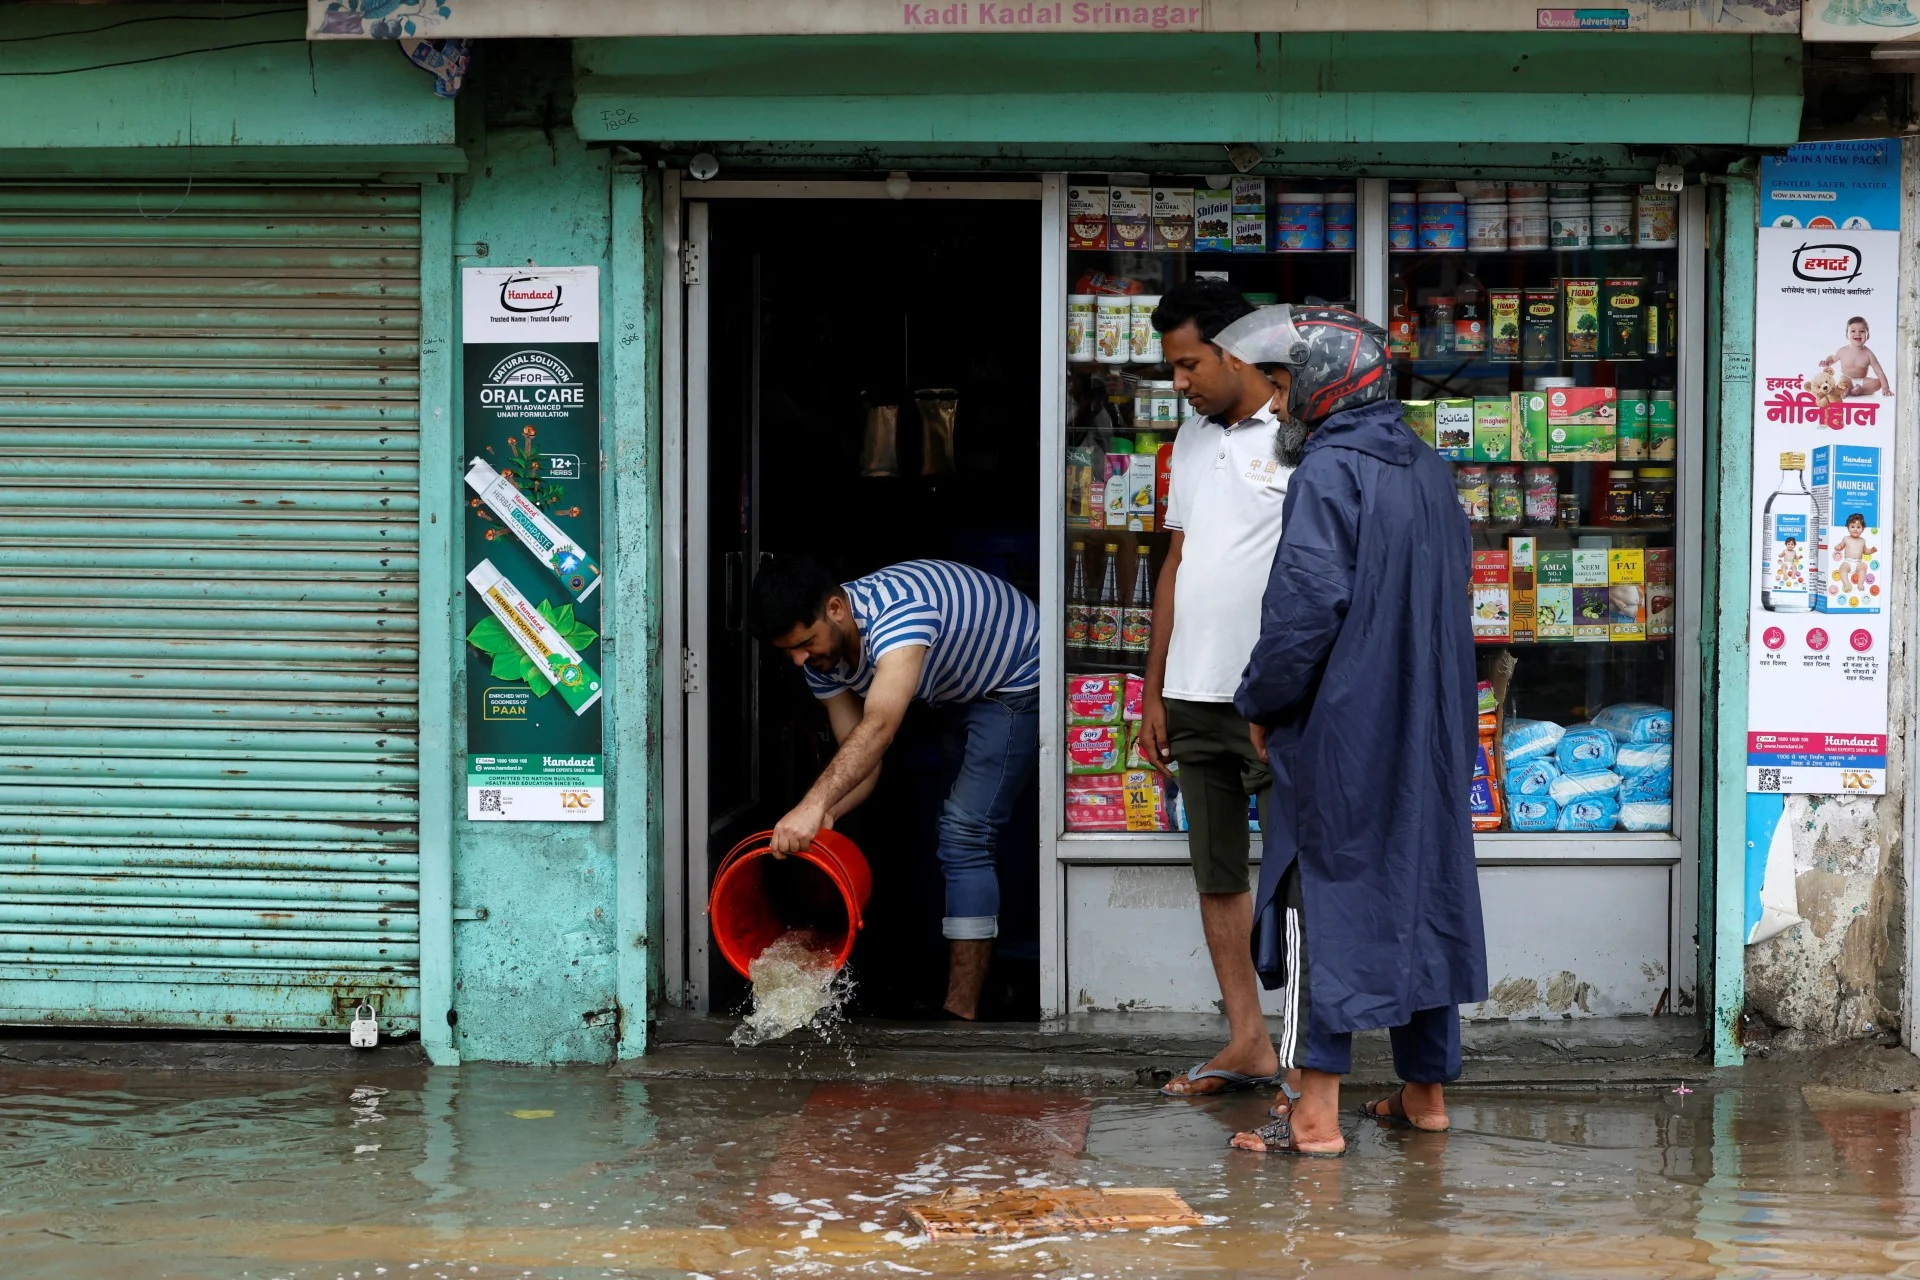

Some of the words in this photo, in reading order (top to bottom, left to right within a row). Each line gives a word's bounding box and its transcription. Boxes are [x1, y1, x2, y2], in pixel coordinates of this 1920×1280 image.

[904, 3, 968, 24] Kadi
[979, 2, 1062, 24] Kadal
[1072, 2, 1200, 28] Srinagar
[1581, 18, 1626, 26] Advertisers
[1820, 143, 1833, 151] BY
[1836, 142, 1884, 151] BILLIONS
[1773, 155, 1798, 164] NOW
[1802, 155, 1814, 164] IN
[1815, 156, 1824, 164] A
[1827, 155, 1848, 165] NEW
[1853, 155, 1881, 165] PACK
[1236, 182, 1262, 194] Shifain
[1196, 203, 1229, 218] Shifain
[1236, 222, 1262, 235] Shifain
[1804, 255, 1849, 271] हमदर्द
[508, 290, 554, 300] Hamdard
[1806, 287, 1817, 295] नाम
[492, 355, 529, 383] NATURAL
[530, 354, 570, 383] SOLUTION
[520, 373, 542, 382] FOR
[1766, 374, 1804, 391] हमदर्द
[480, 388, 529, 403] ORAL
[534, 388, 584, 403] CARE
[1764, 389, 1880, 431] नौनिहाल
[550, 458, 572, 469] 12+
[1842, 456, 1873, 464] Hamdard
[1245, 472, 1272, 483] CHINA
[1837, 480, 1876, 490] NAUNEHAL
[513, 494, 537, 517] Hamdard
[492, 490, 514, 512] HERBAL
[512, 508, 553, 550] TOOTHPASTE
[1616, 562, 1638, 570] FAT
[517, 600, 545, 632] Hamdard
[494, 593, 515, 619] HERBAL
[514, 617, 549, 655] TOOTHPASTE
[492, 706, 526, 714] PAAN
[1825, 736, 1879, 747] Hamdard
[543, 756, 595, 767] Hamdard
[1130, 791, 1148, 804] XL
